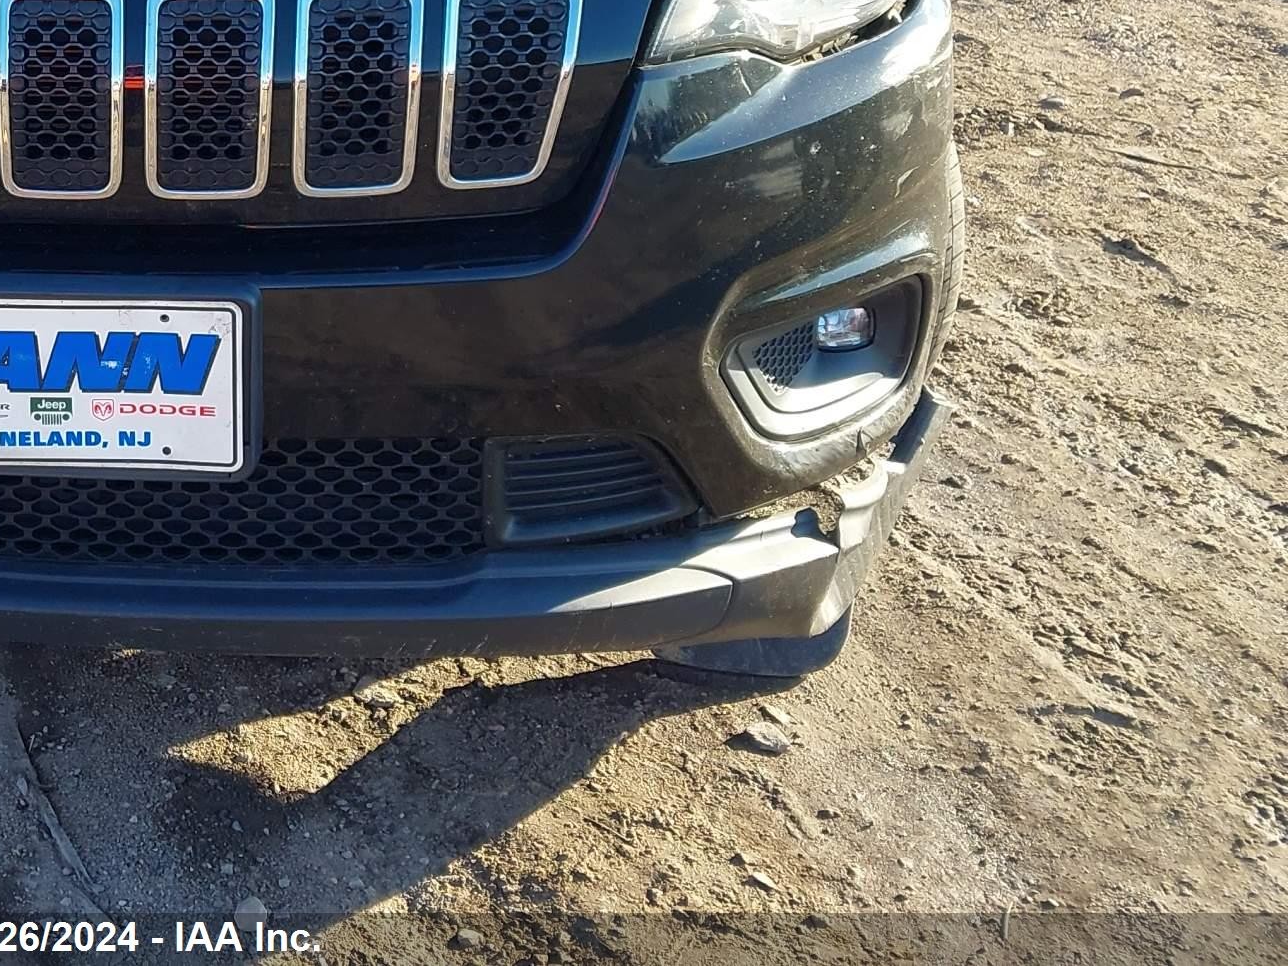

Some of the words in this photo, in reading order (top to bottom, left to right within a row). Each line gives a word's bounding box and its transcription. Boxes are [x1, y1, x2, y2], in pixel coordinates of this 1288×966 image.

[37, 398, 67, 411] Jeep
[119, 403, 217, 417] DODGE
[118, 430, 152, 447] NJ
